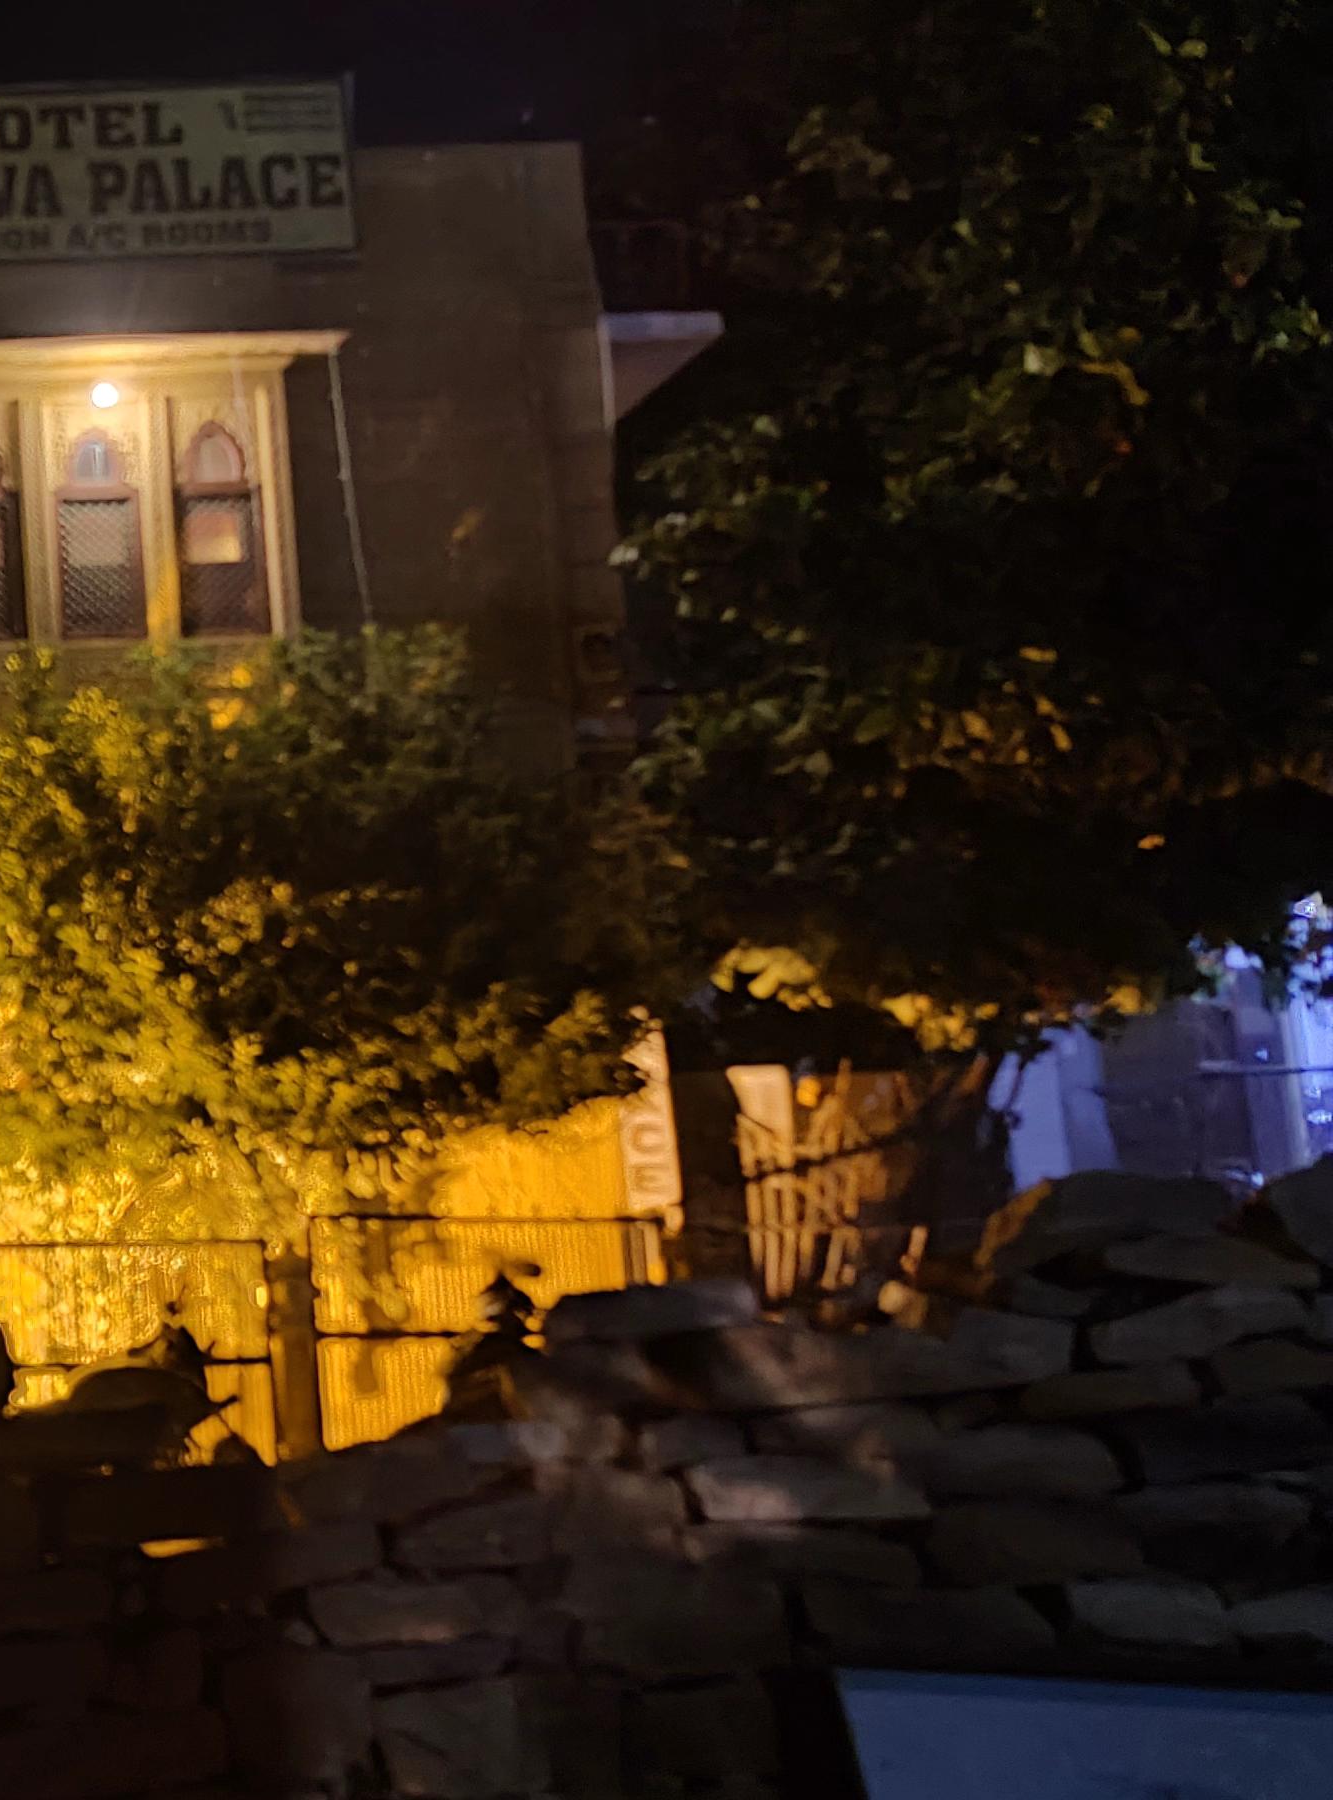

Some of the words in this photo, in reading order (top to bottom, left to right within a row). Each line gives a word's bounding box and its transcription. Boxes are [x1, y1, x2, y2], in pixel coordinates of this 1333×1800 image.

[85, 152, 346, 215] PALACE
[65, 220, 128, 251] A/C
[143, 216, 274, 249] ROOMS
